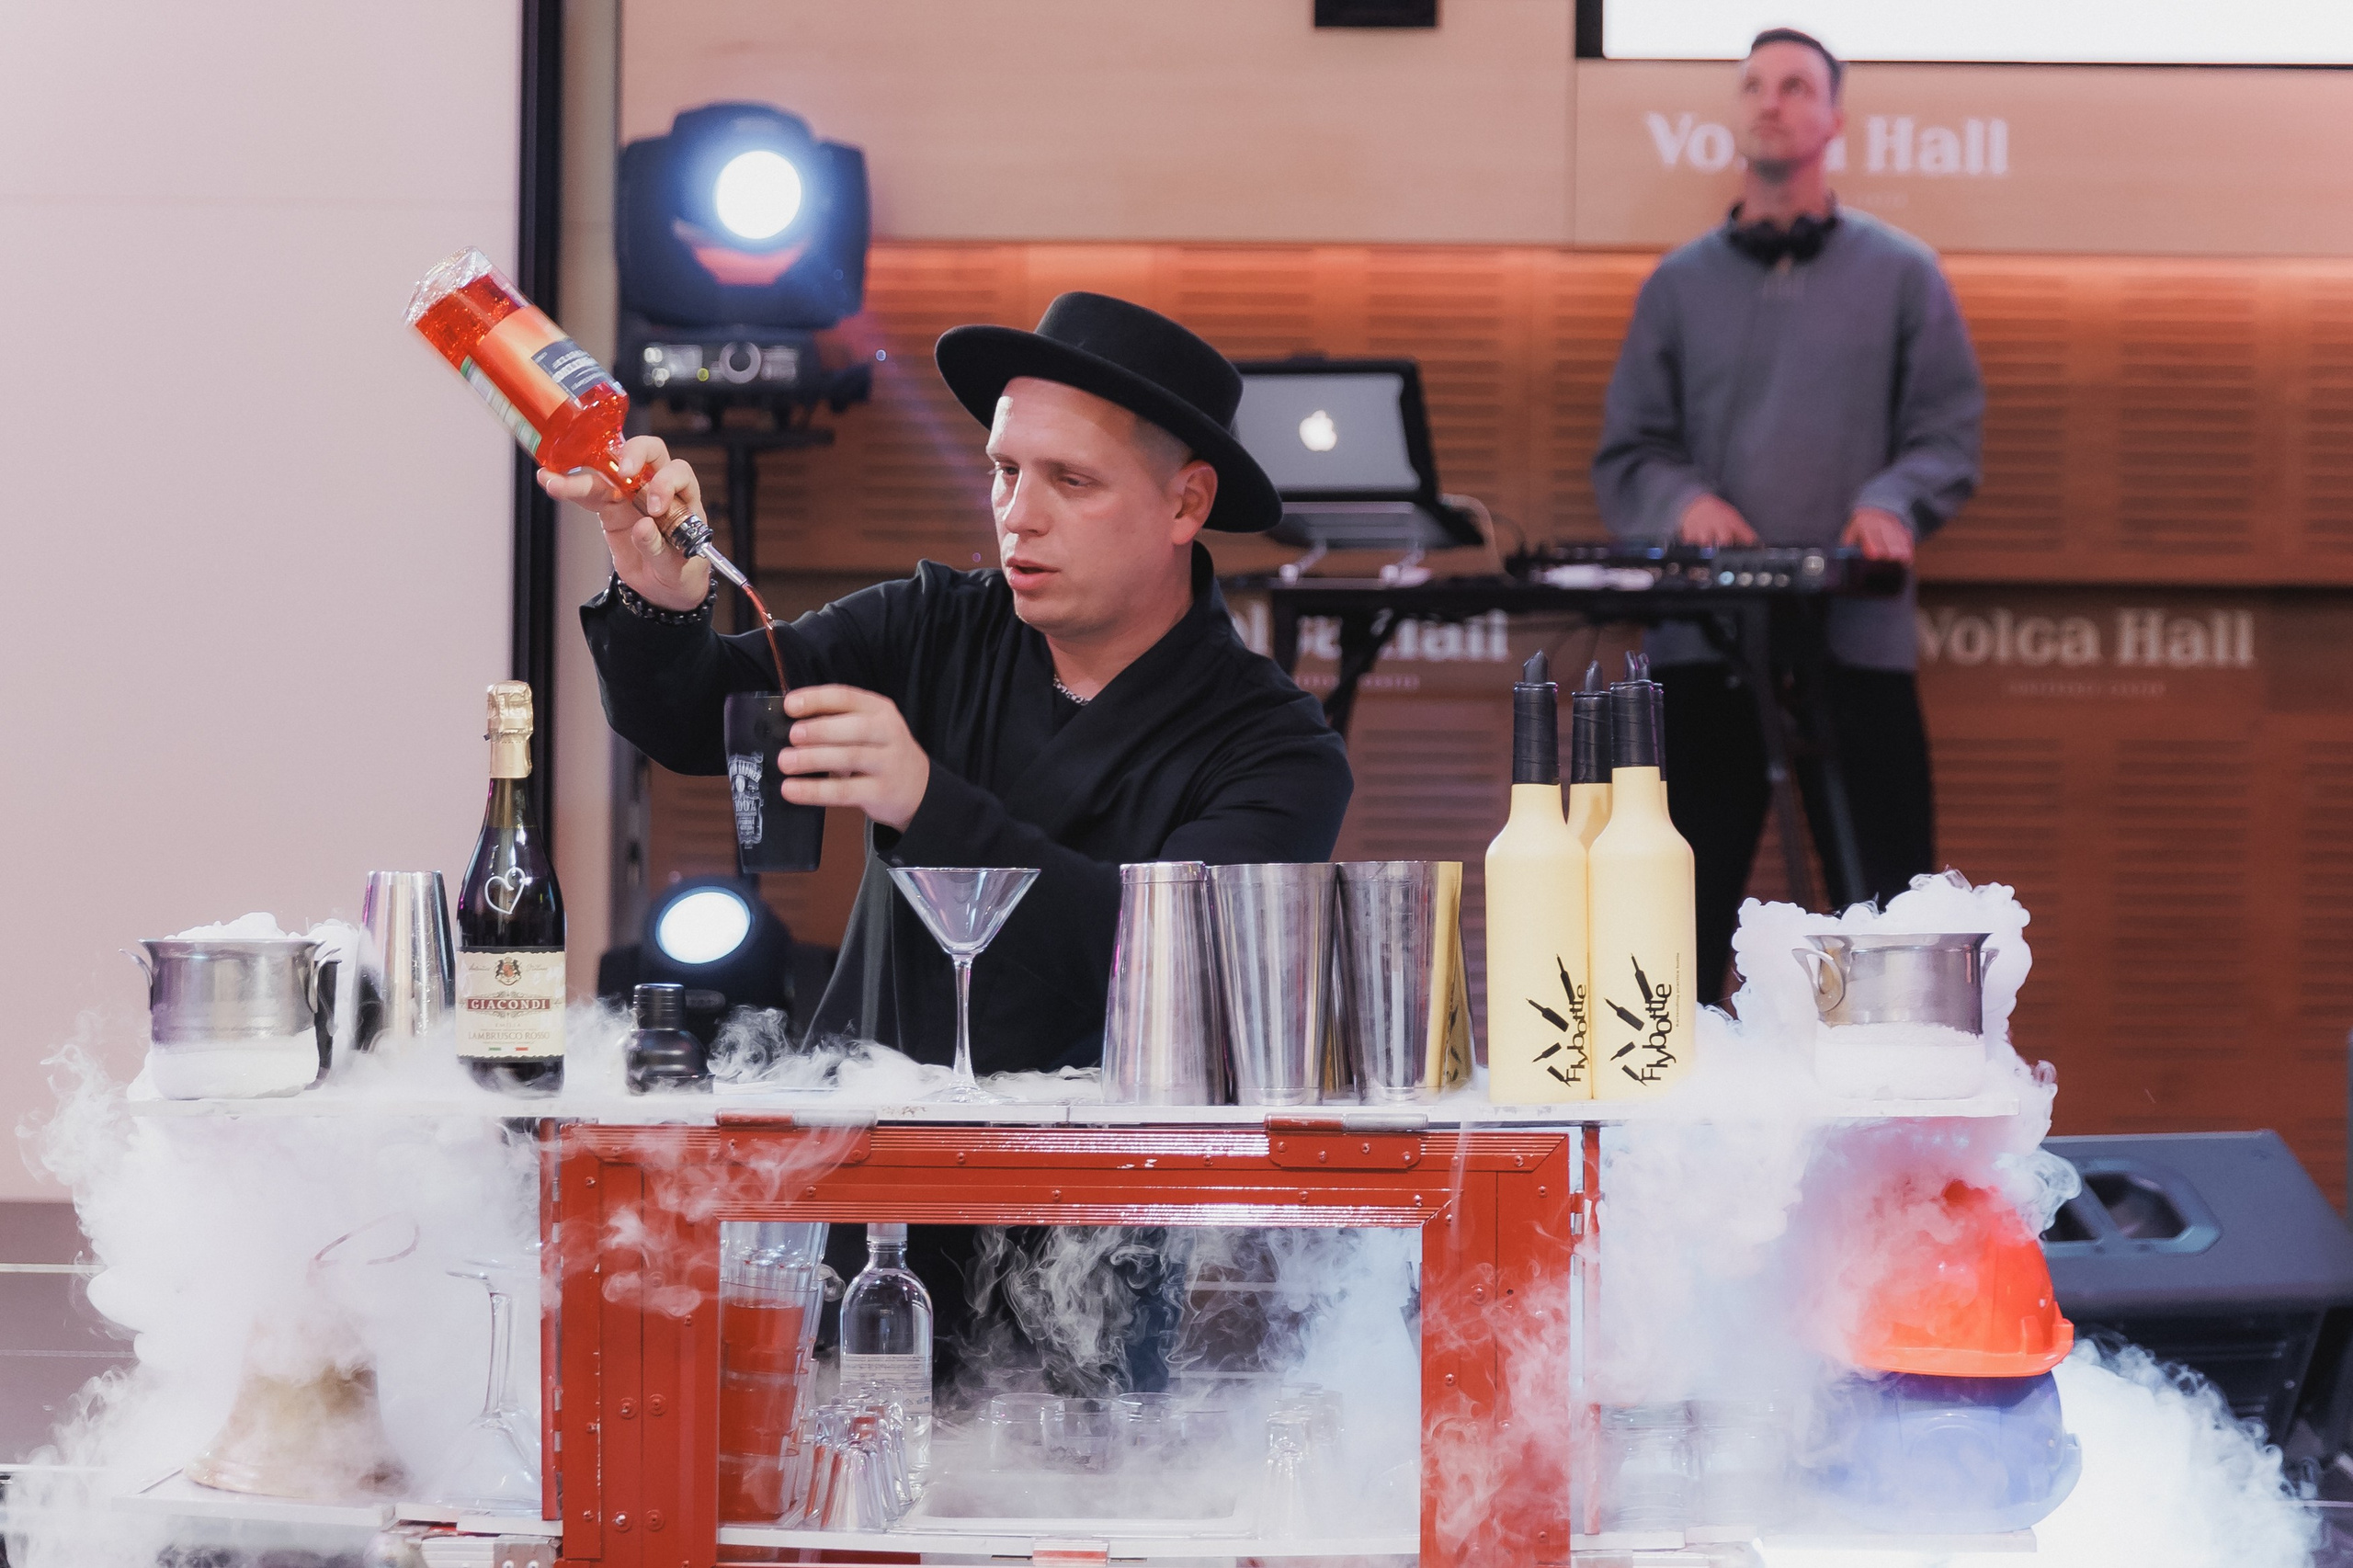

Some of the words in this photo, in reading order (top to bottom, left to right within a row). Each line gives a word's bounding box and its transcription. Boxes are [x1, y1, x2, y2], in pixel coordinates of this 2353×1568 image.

[1865, 115, 2009, 176] Hall
[2117, 608, 2256, 668] Hall
[470, 998, 547, 1010] GIACONDI
[1565, 983, 1590, 1083] Flybottle
[1641, 983, 1677, 1082] Flybottle
[468, 1031, 524, 1040] LAMBRUSCO
[525, 1031, 551, 1040] ROSSO
